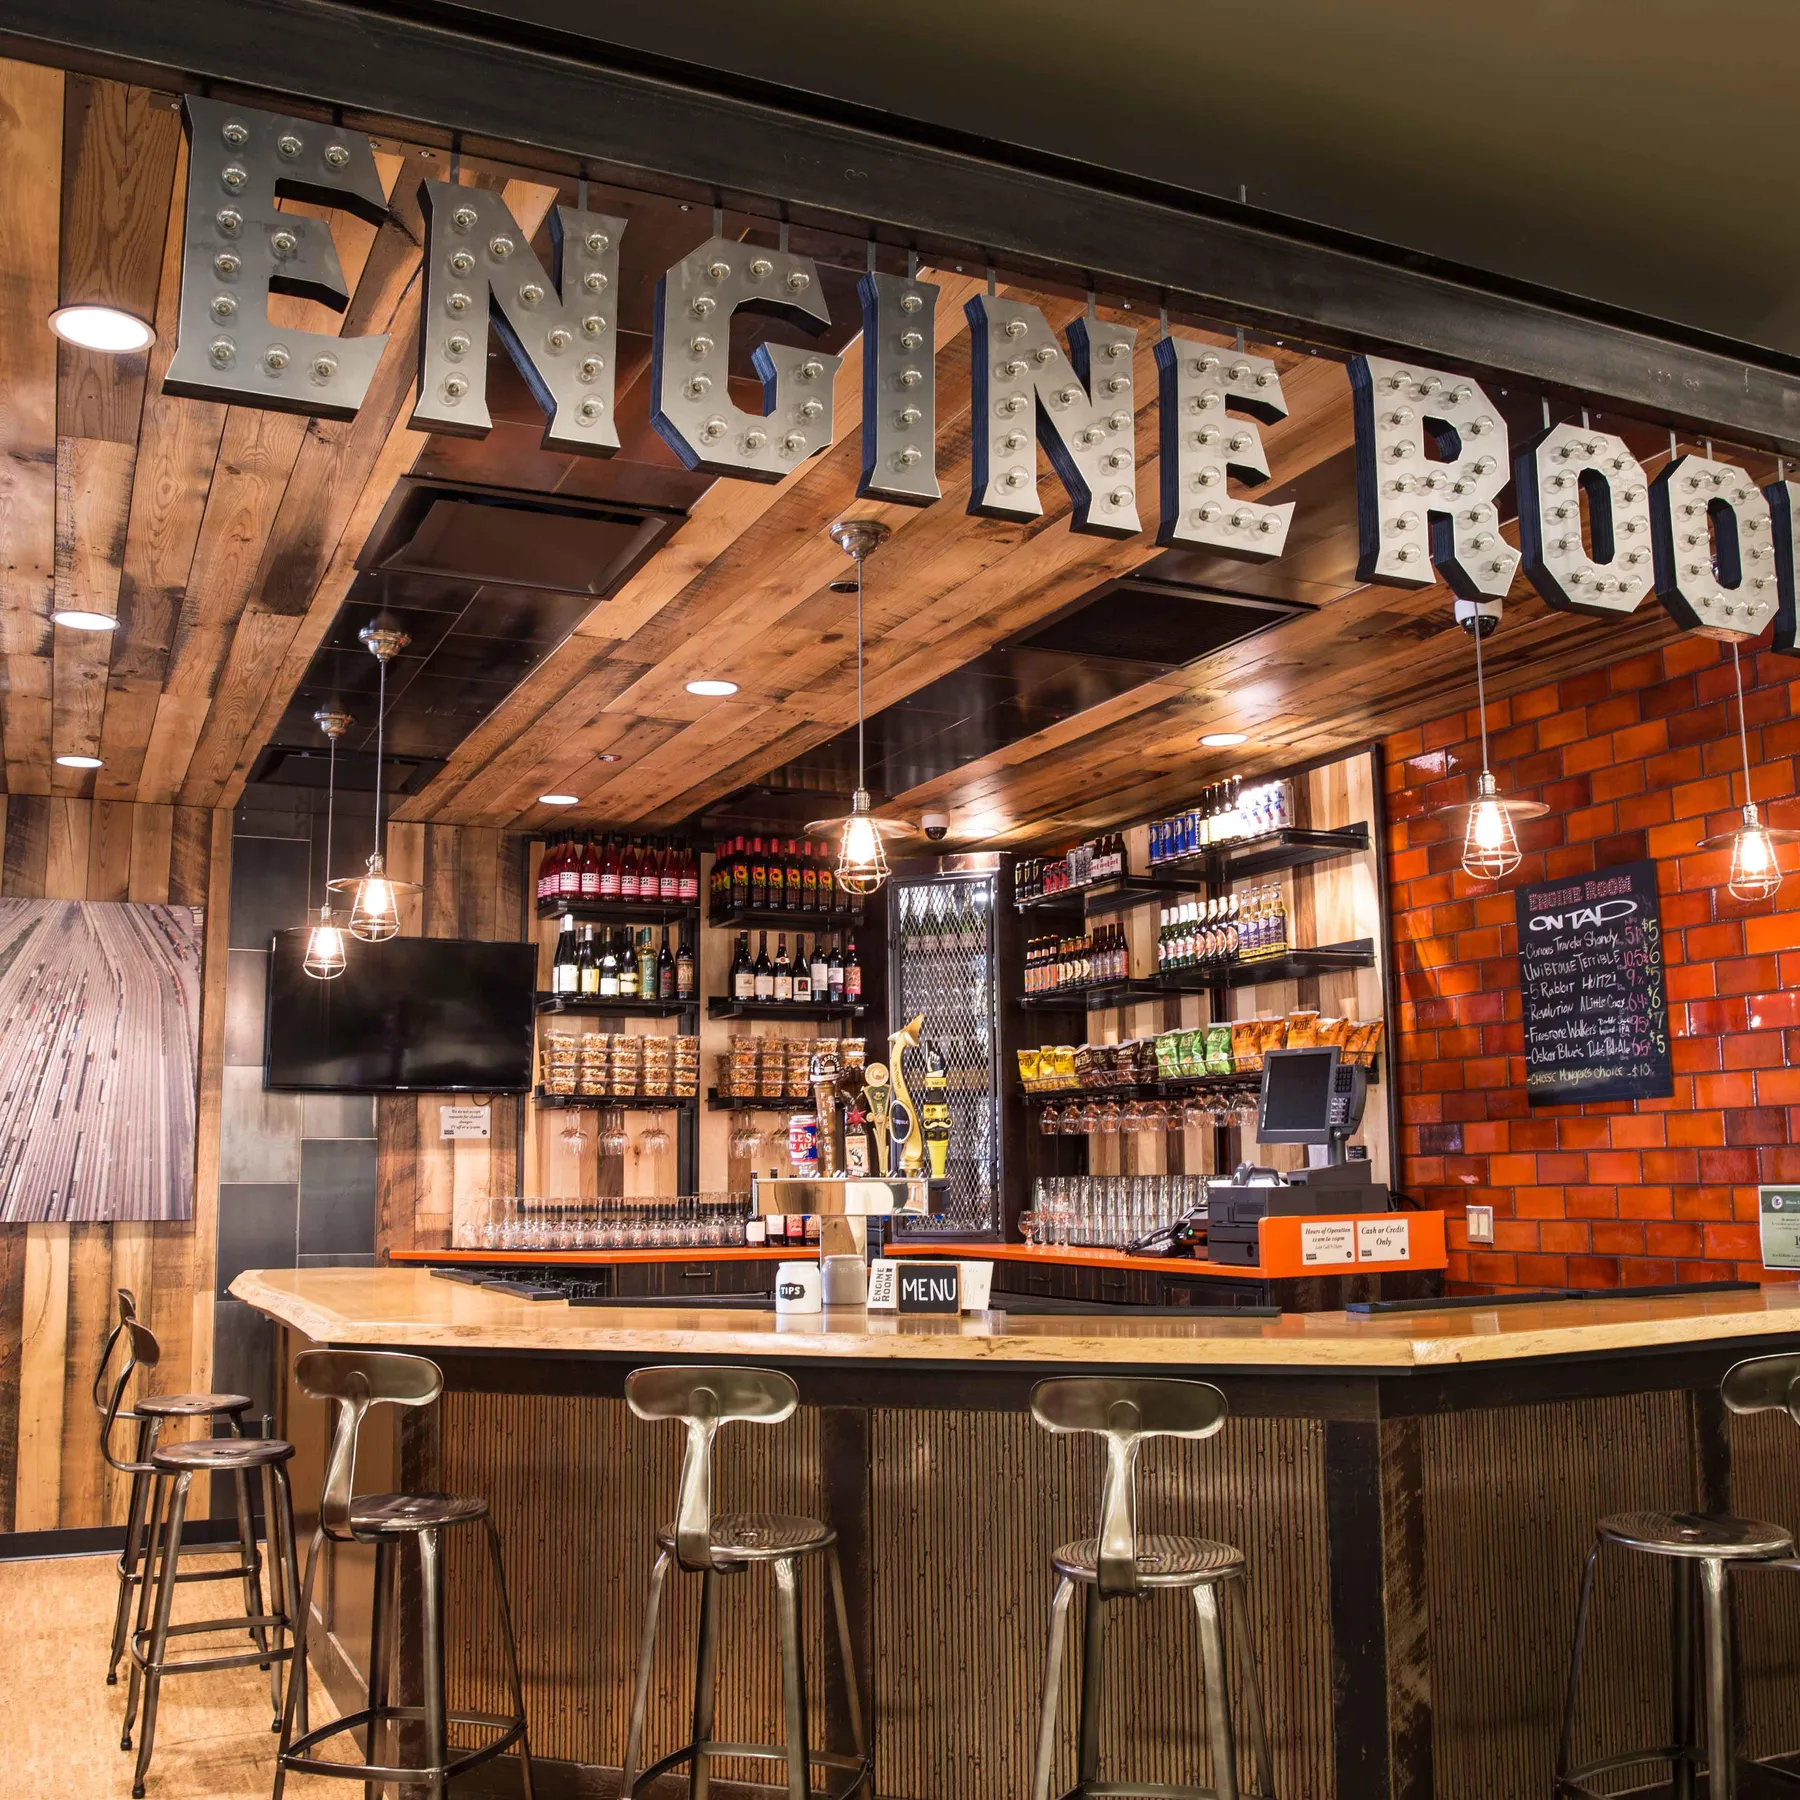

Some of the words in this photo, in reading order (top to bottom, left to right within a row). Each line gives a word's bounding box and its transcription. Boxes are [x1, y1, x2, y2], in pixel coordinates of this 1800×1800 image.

[163, 94, 1296, 562] ENGINE
[1347, 354, 1800, 655] ROO
[1528, 886, 1583, 912] ENGINE
[1584, 875, 1633, 900] ROOM
[1529, 915, 1564, 932] ON
[1564, 899, 1638, 930] TAP
[1361, 1226, 1377, 1235] Cash
[1385, 1225, 1405, 1235] Credit
[1376, 1237, 1392, 1247] Only
[780, 1286, 801, 1296] TIPS
[872, 1267, 885, 1302] ENGINE
[881, 1273, 892, 1302] ROOM
[902, 1277, 957, 1302] MENU
